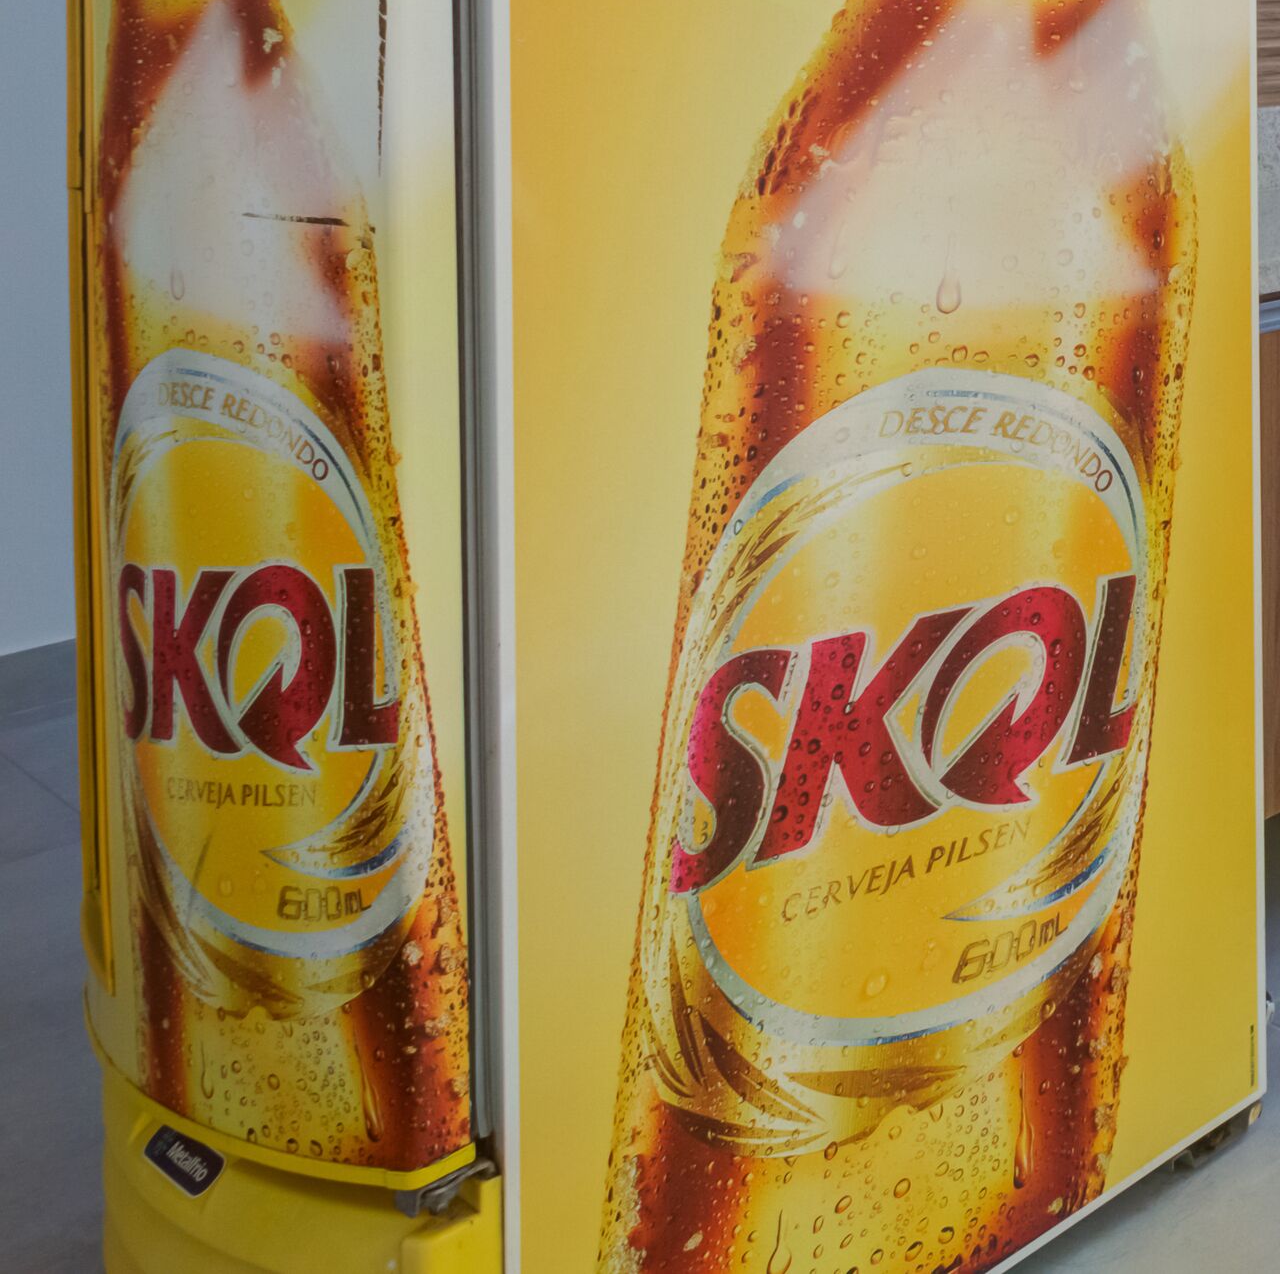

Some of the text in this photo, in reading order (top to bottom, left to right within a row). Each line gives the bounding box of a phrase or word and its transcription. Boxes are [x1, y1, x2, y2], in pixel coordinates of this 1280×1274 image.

[159, 382, 329, 481] DESCE REDONDO
[879, 405, 1113, 493] DESCE REDONDO
[119, 564, 398, 771] SKOL
[670, 575, 1137, 893] SKOL
[168, 777, 317, 809] CERVEJA PILSEN
[782, 818, 1031, 923] CERVEJA PILSEN
